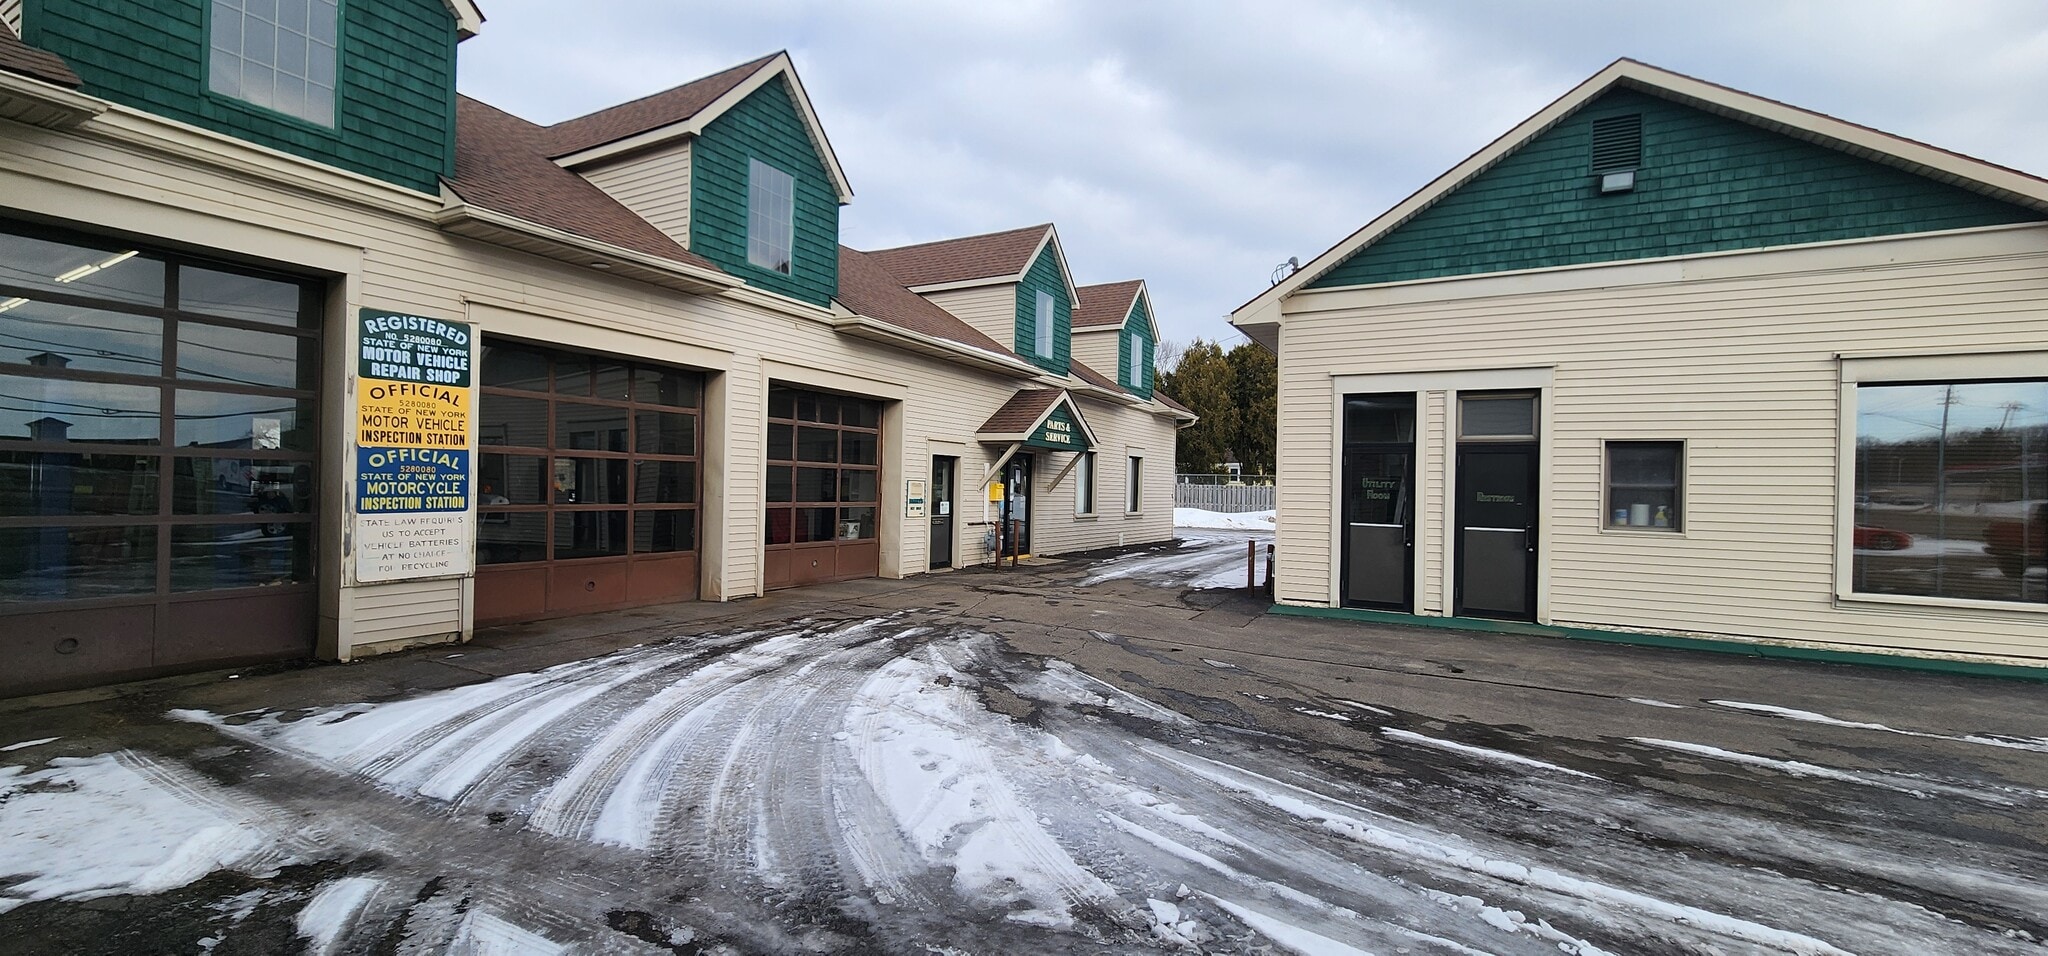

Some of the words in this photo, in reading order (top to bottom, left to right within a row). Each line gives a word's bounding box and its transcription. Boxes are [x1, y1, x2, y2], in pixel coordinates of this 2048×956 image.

[364, 316, 468, 345] REGISTERED
[385, 332, 398, 341] NO.
[403, 334, 442, 346] 5280080
[363, 337, 396, 348] STATE
[400, 342, 414, 350] OF
[417, 345, 439, 354] NEW
[442, 348, 468, 357] YORK
[362, 346, 411, 364] MOTOR
[416, 352, 468, 371] VEHICLE
[371, 362, 421, 380] REPAIR
[426, 369, 461, 384] SHOP
[370, 384, 460, 407] OFFICIAL
[361, 405, 393, 414] STATE
[416, 409, 437, 417] NEW
[399, 400, 436, 409] 5280080
[362, 415, 409, 429] MOTOR
[416, 418, 465, 432] VEHICLE
[1046, 419, 1065, 432] PARTS
[1066, 423, 1071, 432] &
[361, 430, 422, 444] INSPECTION
[426, 433, 465, 446] STATION
[1045, 432, 1071, 444] SERVICE
[368, 449, 459, 470] OFFICIAL
[400, 465, 436, 473] 5280080
[367, 482, 460, 495] MOTORCYCLE
[361, 497, 421, 510] INSPECTION
[426, 496, 465, 509] STATION
[394, 518, 417, 526] LAW
[398, 529, 411, 537] TO
[413, 528, 446, 536] ACCEPT
[409, 539, 459, 548] BATTERIES
[401, 561, 449, 571] RECYCLING
